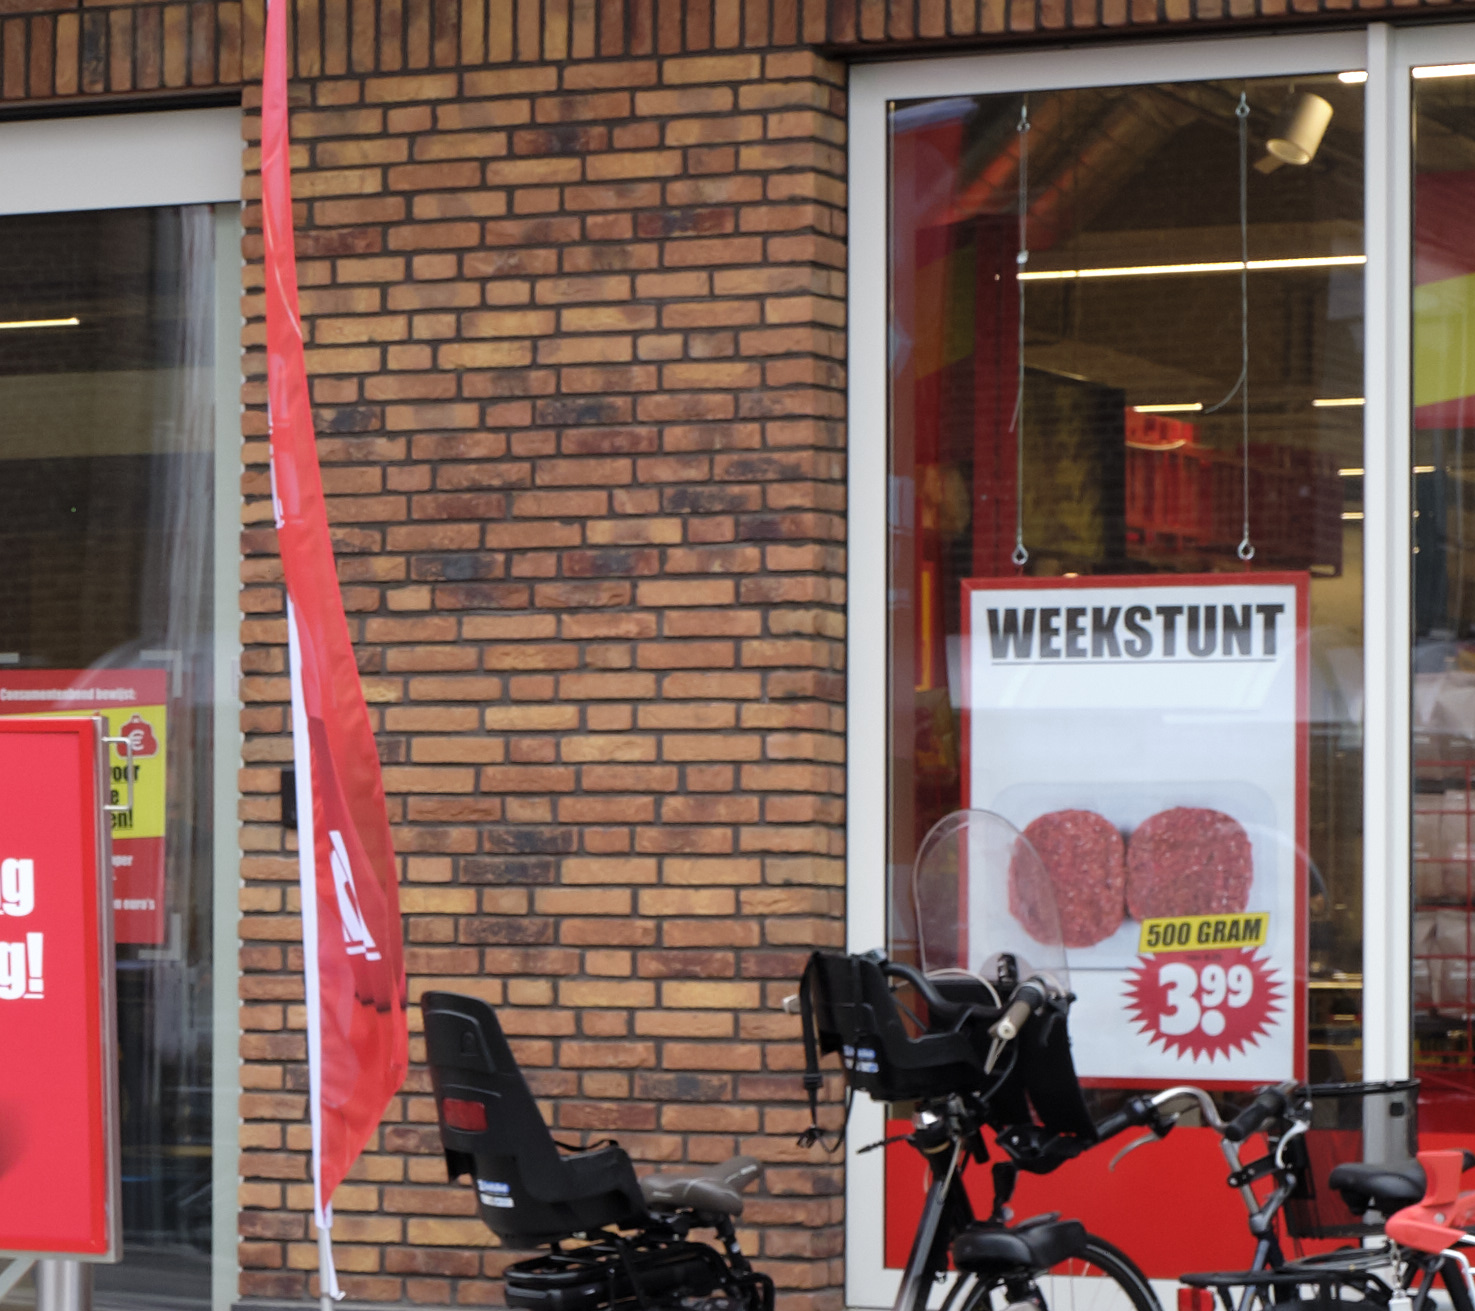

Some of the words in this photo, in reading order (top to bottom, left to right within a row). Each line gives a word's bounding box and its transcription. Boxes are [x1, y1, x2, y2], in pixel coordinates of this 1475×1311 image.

[986, 602, 1286, 660] WEEKSTUNT
[1147, 922, 1192, 948] 500
[1197, 917, 1264, 945] GRAM
